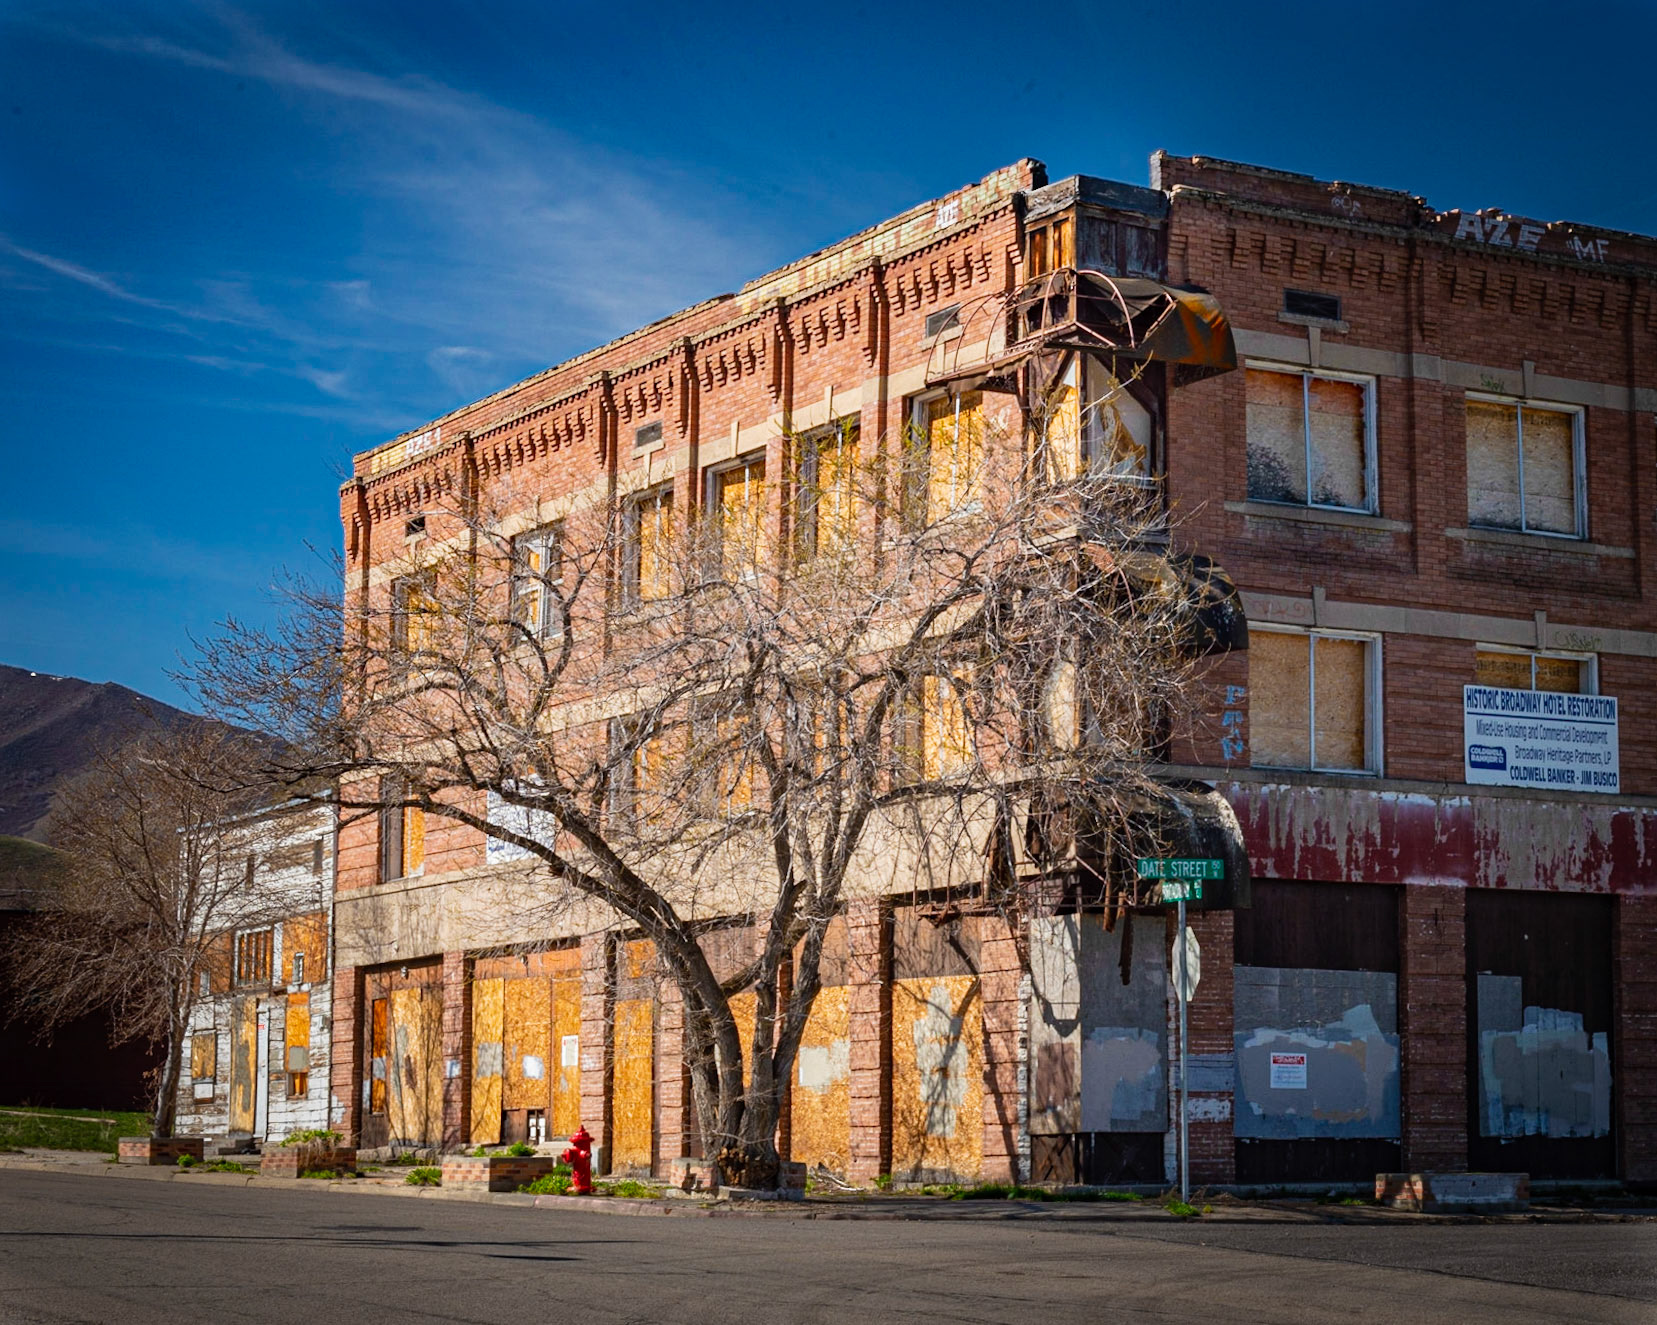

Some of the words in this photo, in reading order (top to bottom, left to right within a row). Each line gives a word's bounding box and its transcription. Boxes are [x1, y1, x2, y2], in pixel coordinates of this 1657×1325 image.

[1454, 213, 1546, 250] AZE
[1466, 688, 1499, 709] HISTORIC
[1501, 691, 1542, 713] BROADWAY
[1543, 694, 1566, 715] HOTEL
[1568, 697, 1616, 719] RESTORATION
[1476, 719, 1504, 737] Mixed-Use
[1505, 722, 1527, 741] Housing
[1528, 725, 1538, 740] and
[1539, 725, 1571, 742] Commercial
[1572, 727, 1608, 746] Development
[1515, 745, 1546, 764] Broadway
[1547, 748, 1573, 764] Heritage
[1604, 753, 1612, 765] LP
[1510, 766, 1546, 782] COLDWELL
[1547, 767, 1575, 783] BANKER
[1580, 771, 1592, 785] JIM
[1593, 772, 1617, 787] BUSICO
[1141, 861, 1166, 877] DATE
[1171, 861, 1207, 877] STREET
